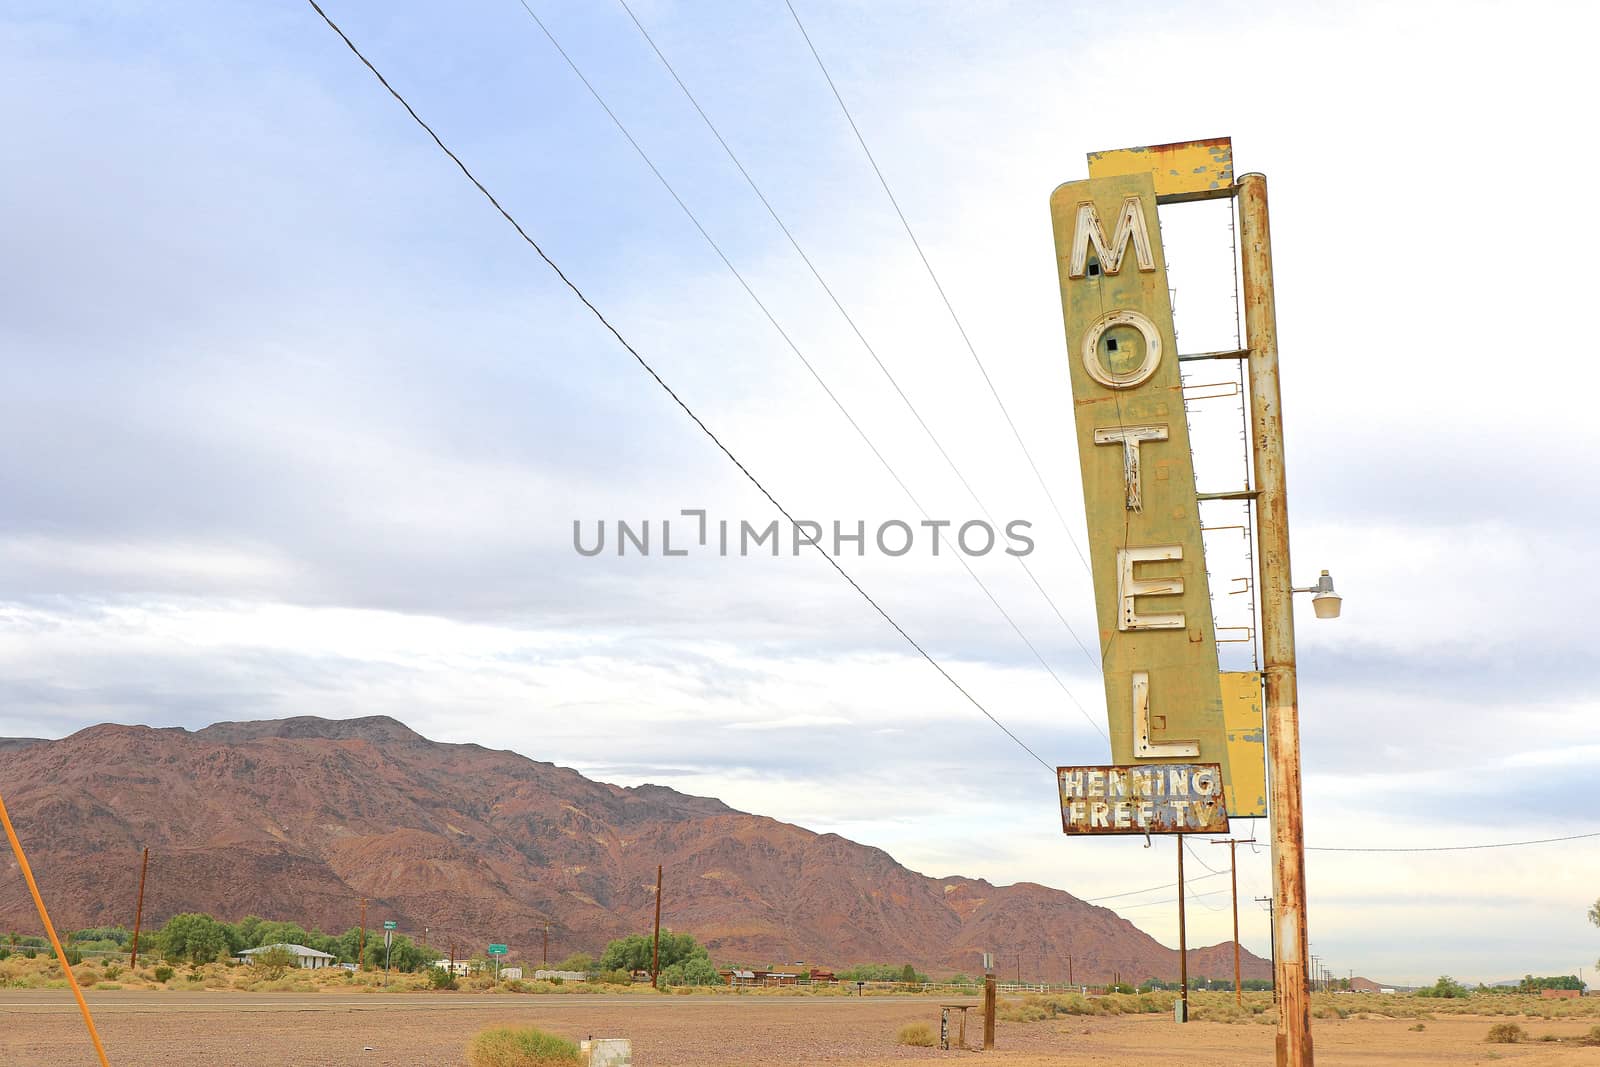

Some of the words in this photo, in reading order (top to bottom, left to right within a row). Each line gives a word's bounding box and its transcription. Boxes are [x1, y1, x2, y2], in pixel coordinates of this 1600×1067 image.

[1069, 195, 1199, 759] MOTEL
[1064, 769, 1215, 797] HENNING
[1069, 801, 1154, 828] FREE
[1170, 800, 1214, 828] TV
